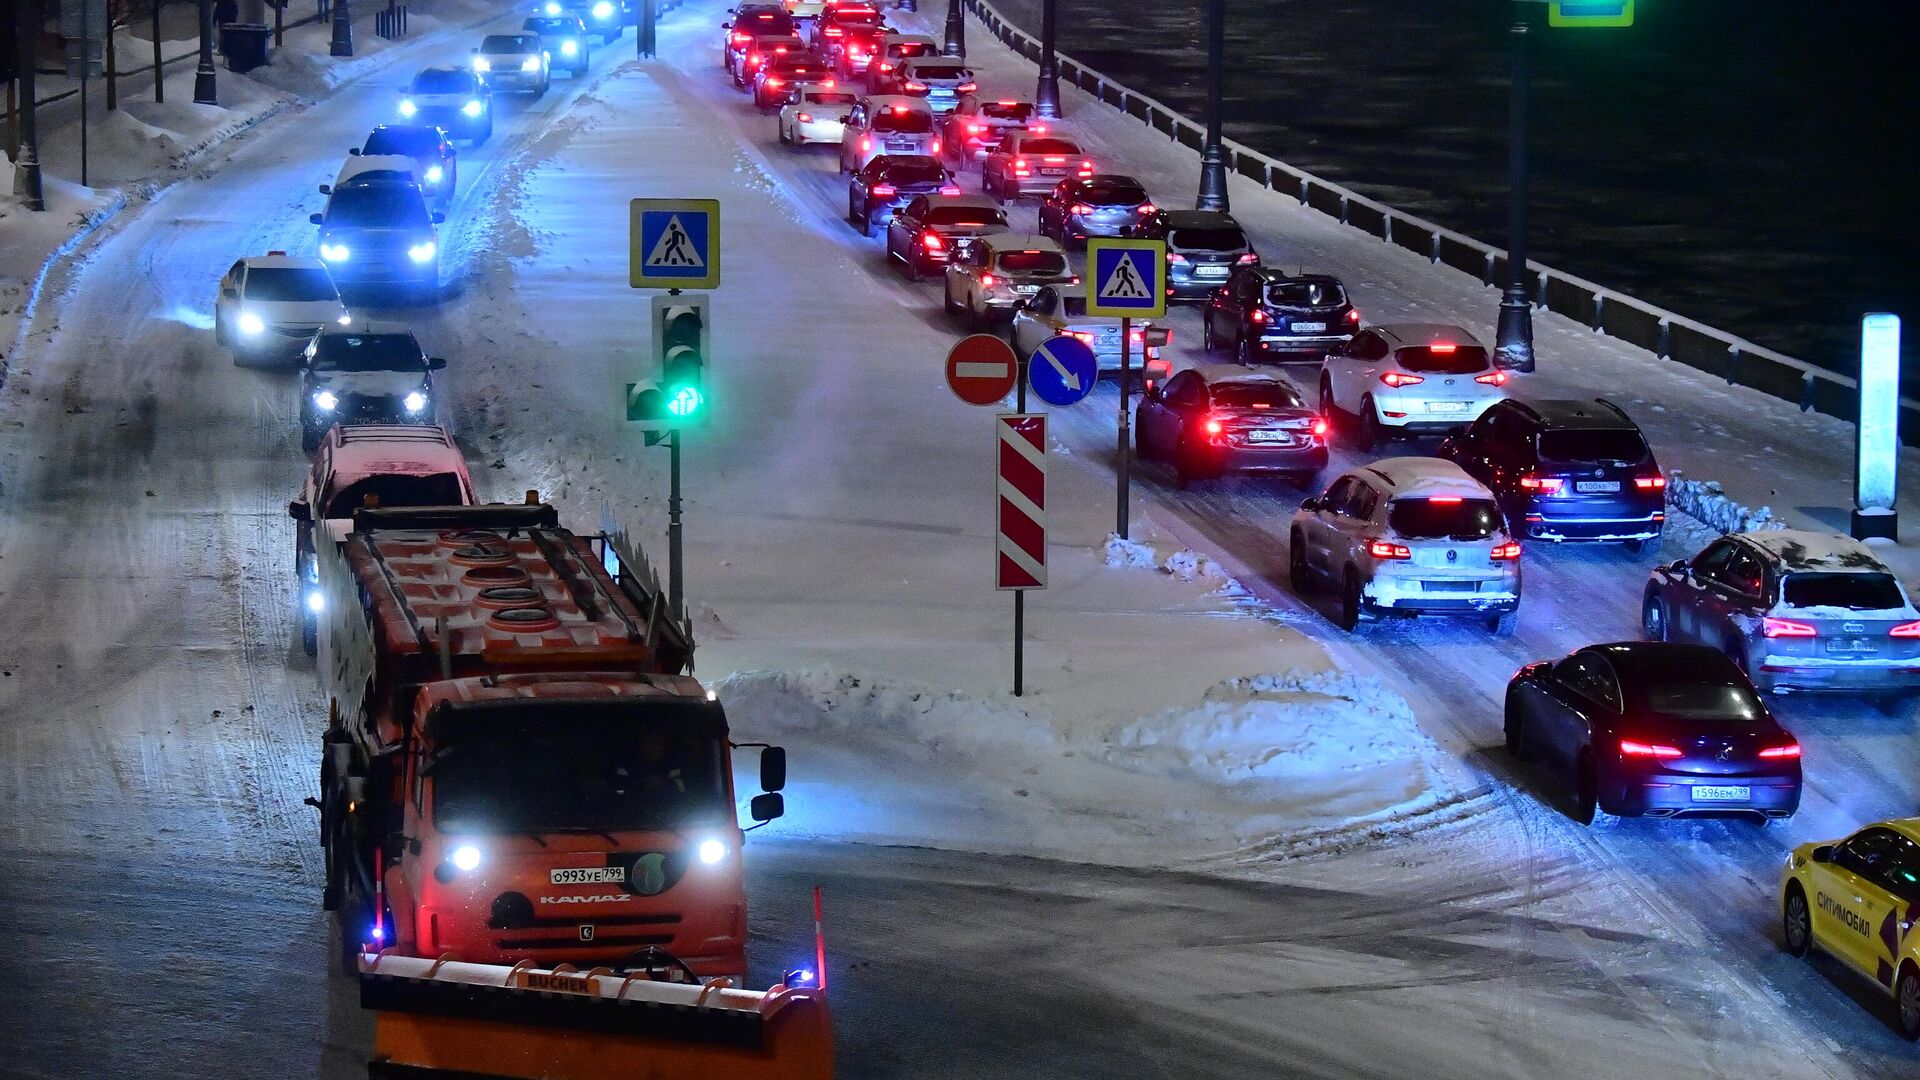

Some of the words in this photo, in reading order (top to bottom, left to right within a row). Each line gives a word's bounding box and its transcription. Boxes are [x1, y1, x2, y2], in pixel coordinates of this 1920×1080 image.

[554, 869, 602, 882] О993УЕ
[603, 868, 622, 878] 799
[540, 894, 632, 904] KAMAZ
[1816, 890, 1870, 938] СИТИМОБИЛ
[527, 973, 589, 994] BUCHER
